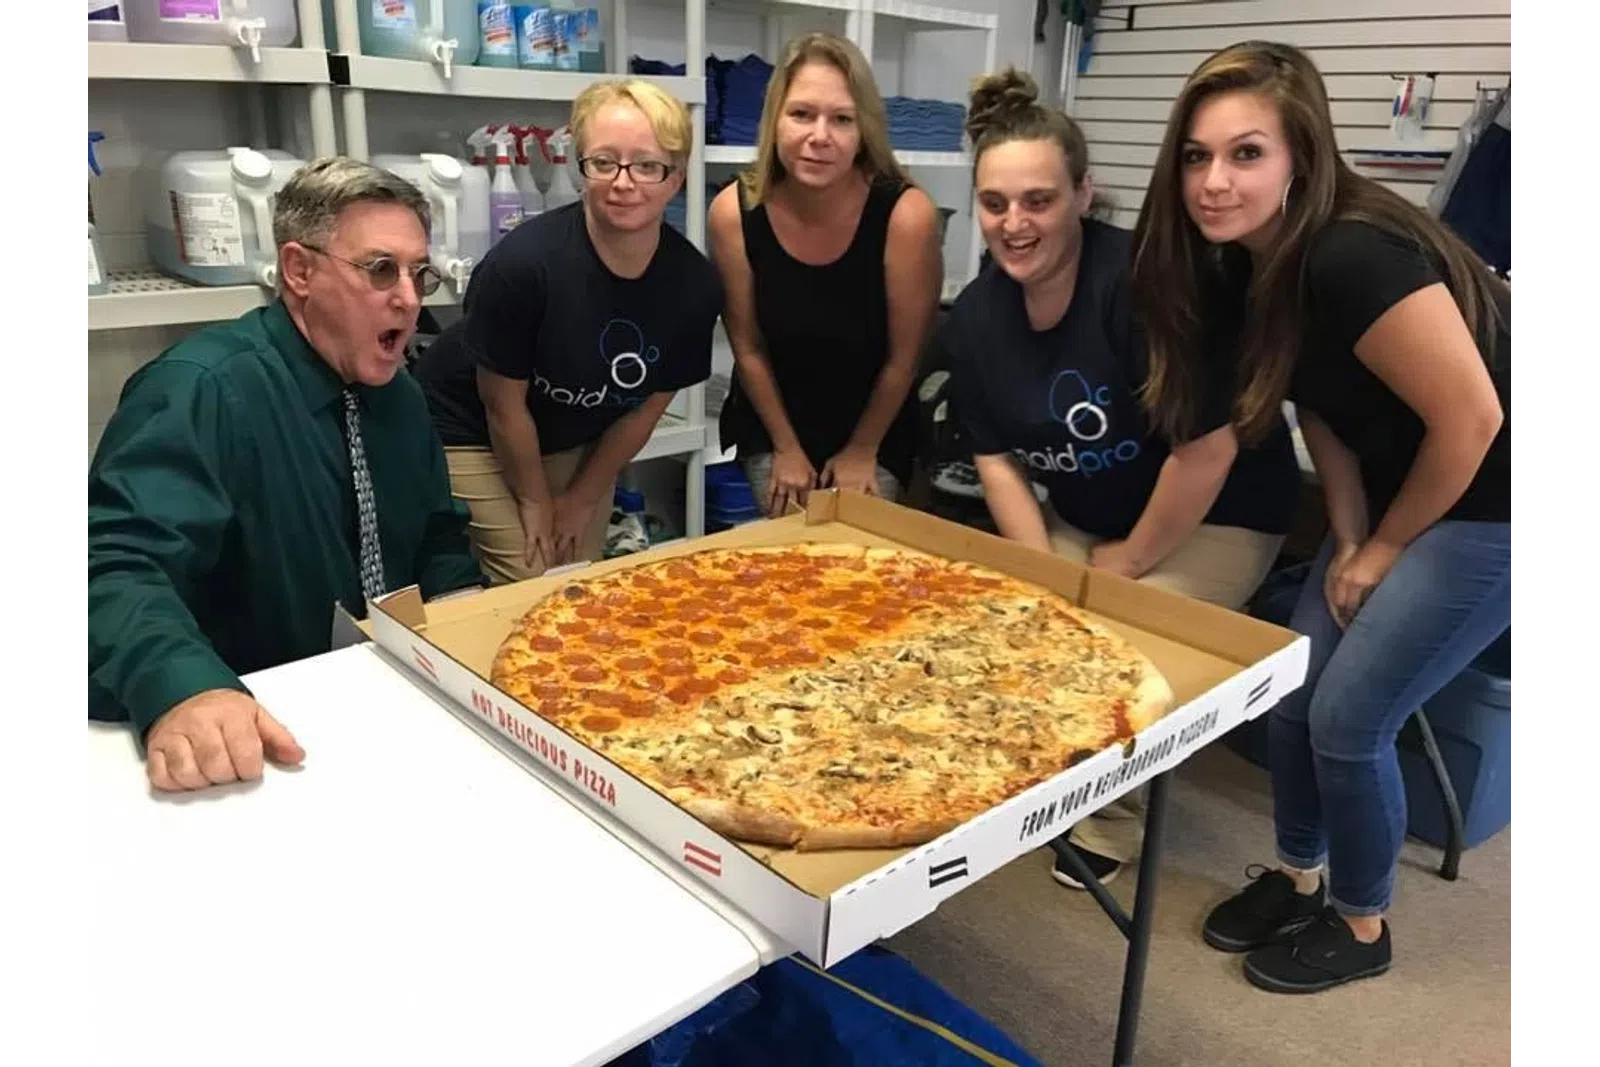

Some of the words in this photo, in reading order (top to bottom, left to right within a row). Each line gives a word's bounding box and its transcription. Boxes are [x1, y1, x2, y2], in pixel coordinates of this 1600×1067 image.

[471, 688, 493, 719] HOT
[497, 706, 568, 772] DELICIOUS
[574, 758, 616, 808] PIZZA
[1019, 800, 1057, 842] FROM
[1058, 781, 1093, 821] YOUR
